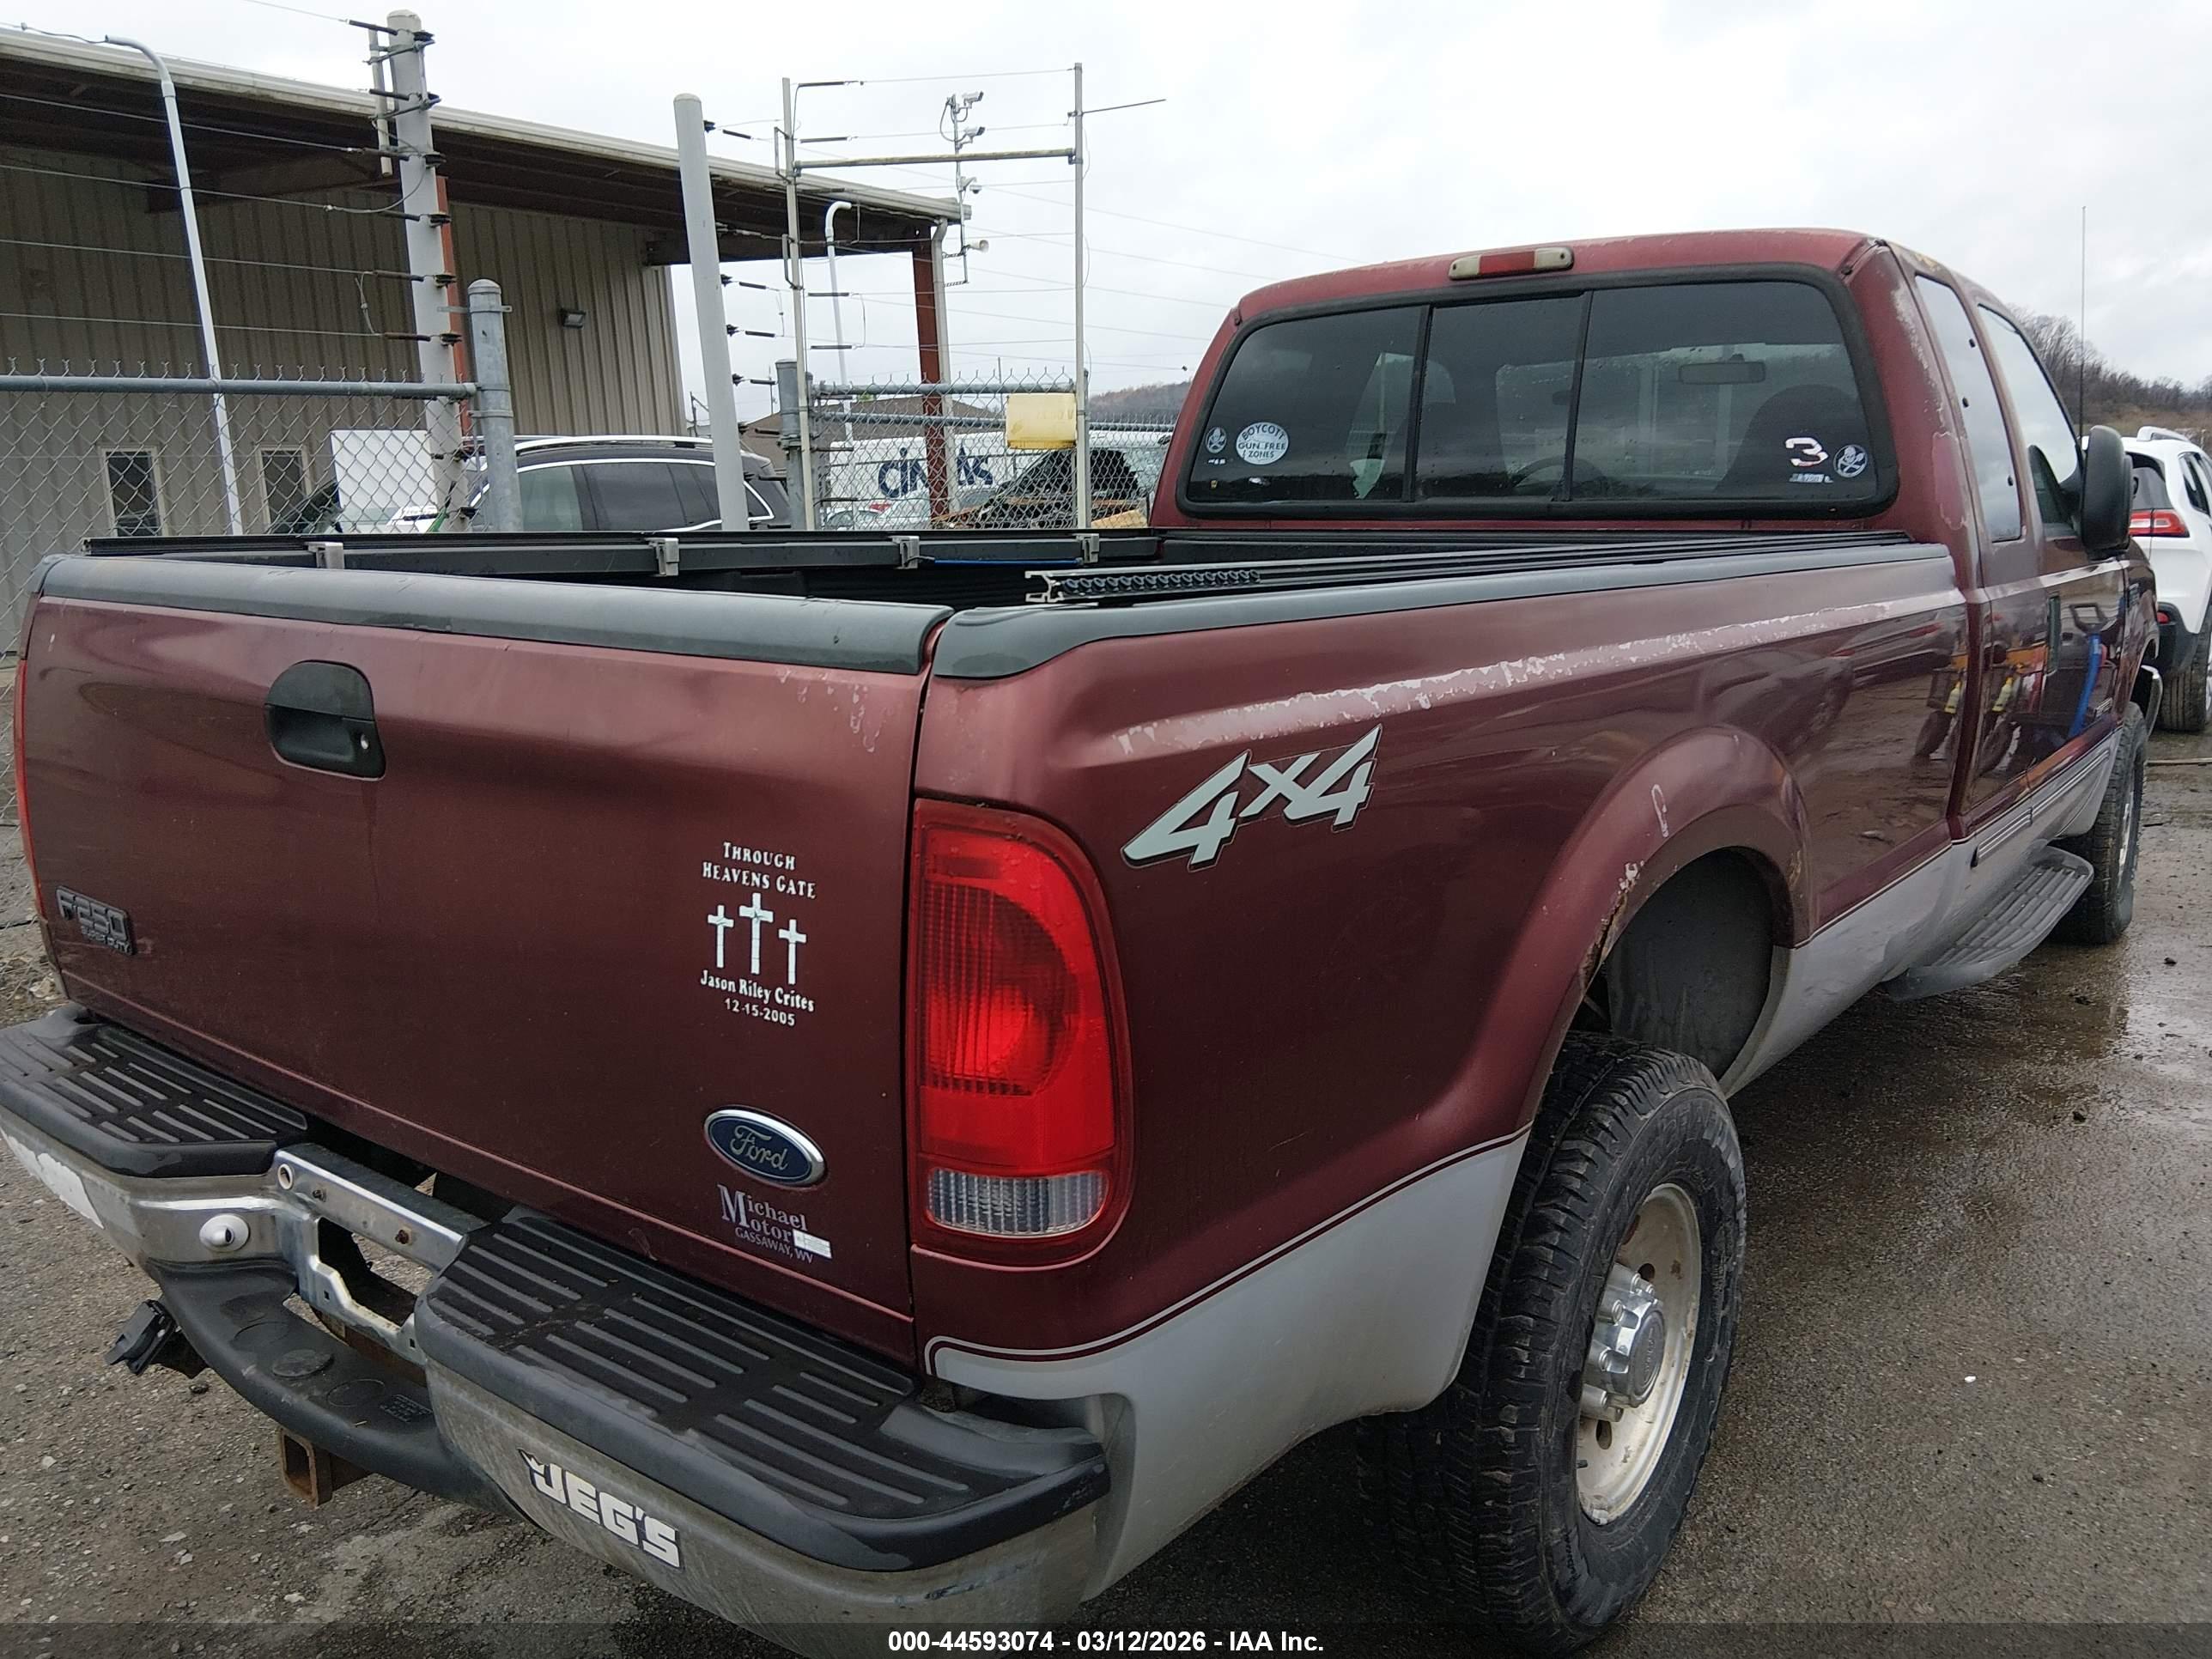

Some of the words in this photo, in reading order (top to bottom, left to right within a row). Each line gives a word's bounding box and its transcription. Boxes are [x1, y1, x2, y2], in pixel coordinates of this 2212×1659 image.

[1242, 424, 1286, 441] BOYCOTT
[1249, 450, 1275, 459] ZONES
[1785, 437, 1829, 466] 3
[723, 842, 796, 871] THROUGH
[702, 861, 770, 890] HEAVENS
[776, 875, 817, 900] GATE
[700, 969, 737, 993] Jason
[739, 979, 771, 1005] Riley
[775, 988, 815, 1012] Crites
[725, 998, 795, 1027] 12-15-2005
[730, 1125, 789, 1171] Ford
[717, 1184, 808, 1231] Michael
[794, 1248, 814, 1264] WV
[526, 1456, 682, 1570] JEG'S
